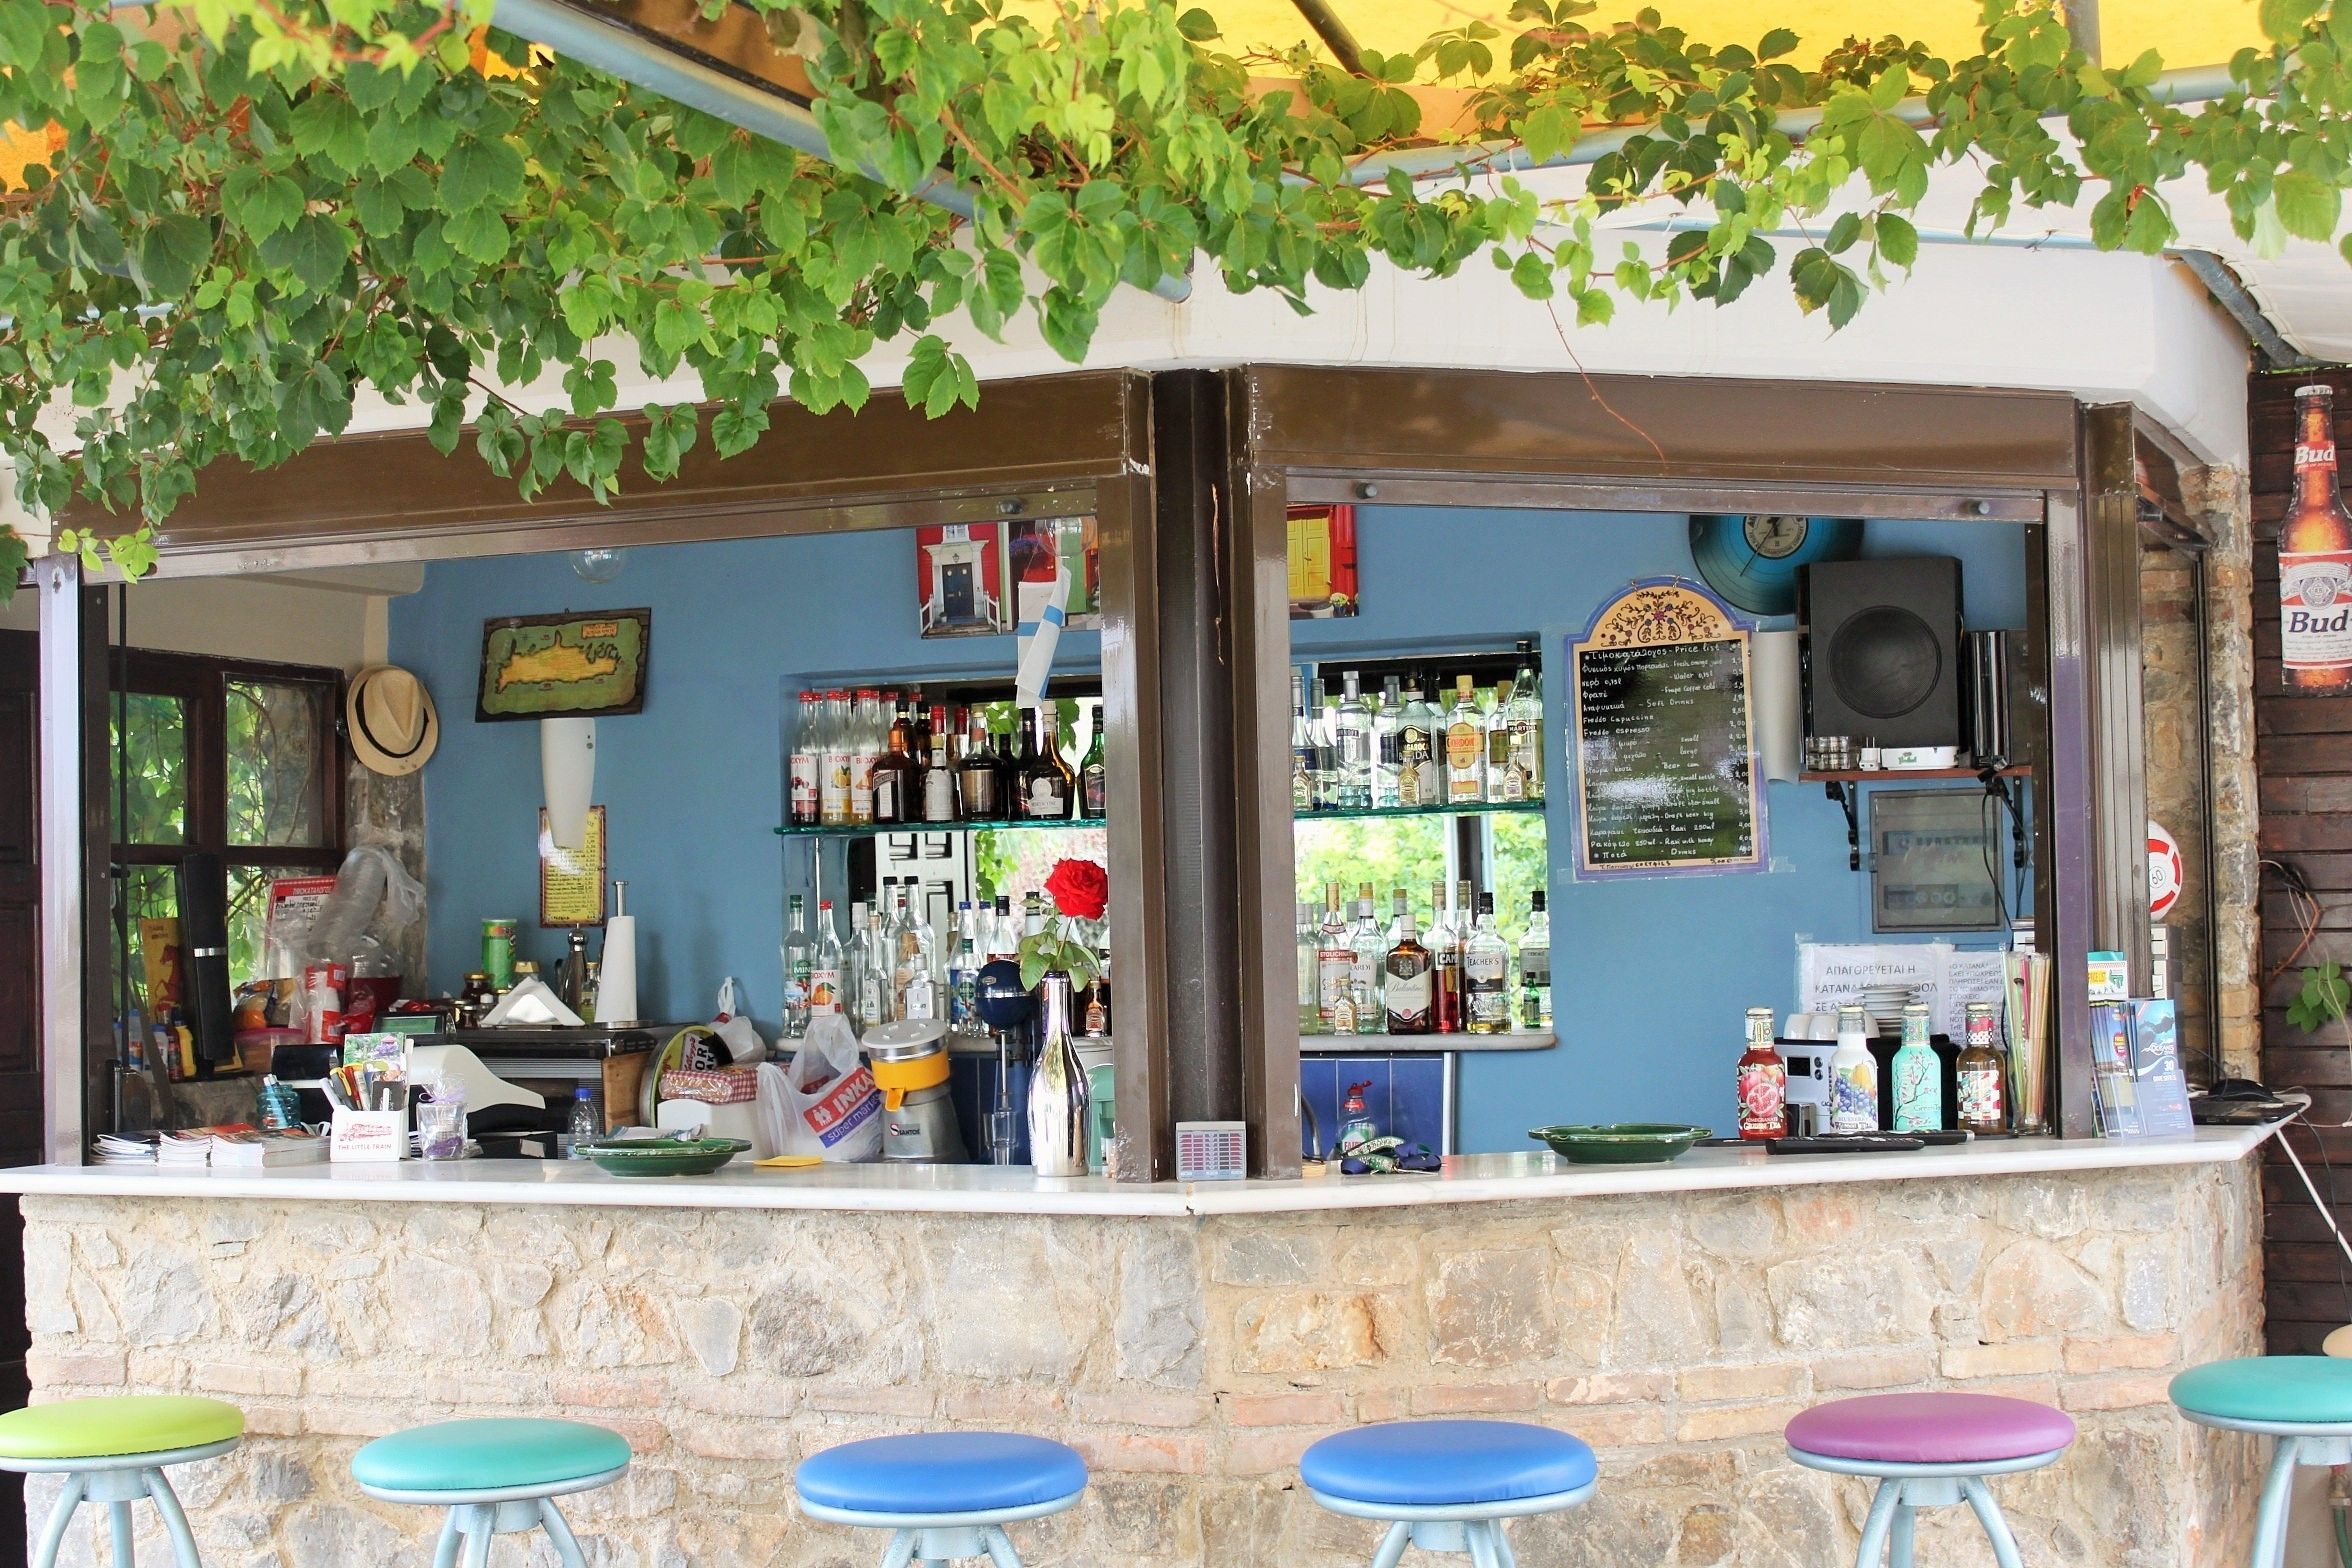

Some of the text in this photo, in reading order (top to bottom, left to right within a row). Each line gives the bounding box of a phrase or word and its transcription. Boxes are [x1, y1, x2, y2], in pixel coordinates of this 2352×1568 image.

[2294, 445, 2335, 465] Bud
[2288, 609, 2349, 633] Bud
[1675, 645, 1699, 653] Price
[1703, 642, 1720, 652] list
[1583, 715, 1607, 724] Freddo
[1584, 728, 1610, 736] Freddo
[1615, 726, 1650, 734] espresso
[1467, 957, 1500, 968] TEACHER'S
[833, 1073, 875, 1114] INKA
[827, 1119, 852, 1141] super
